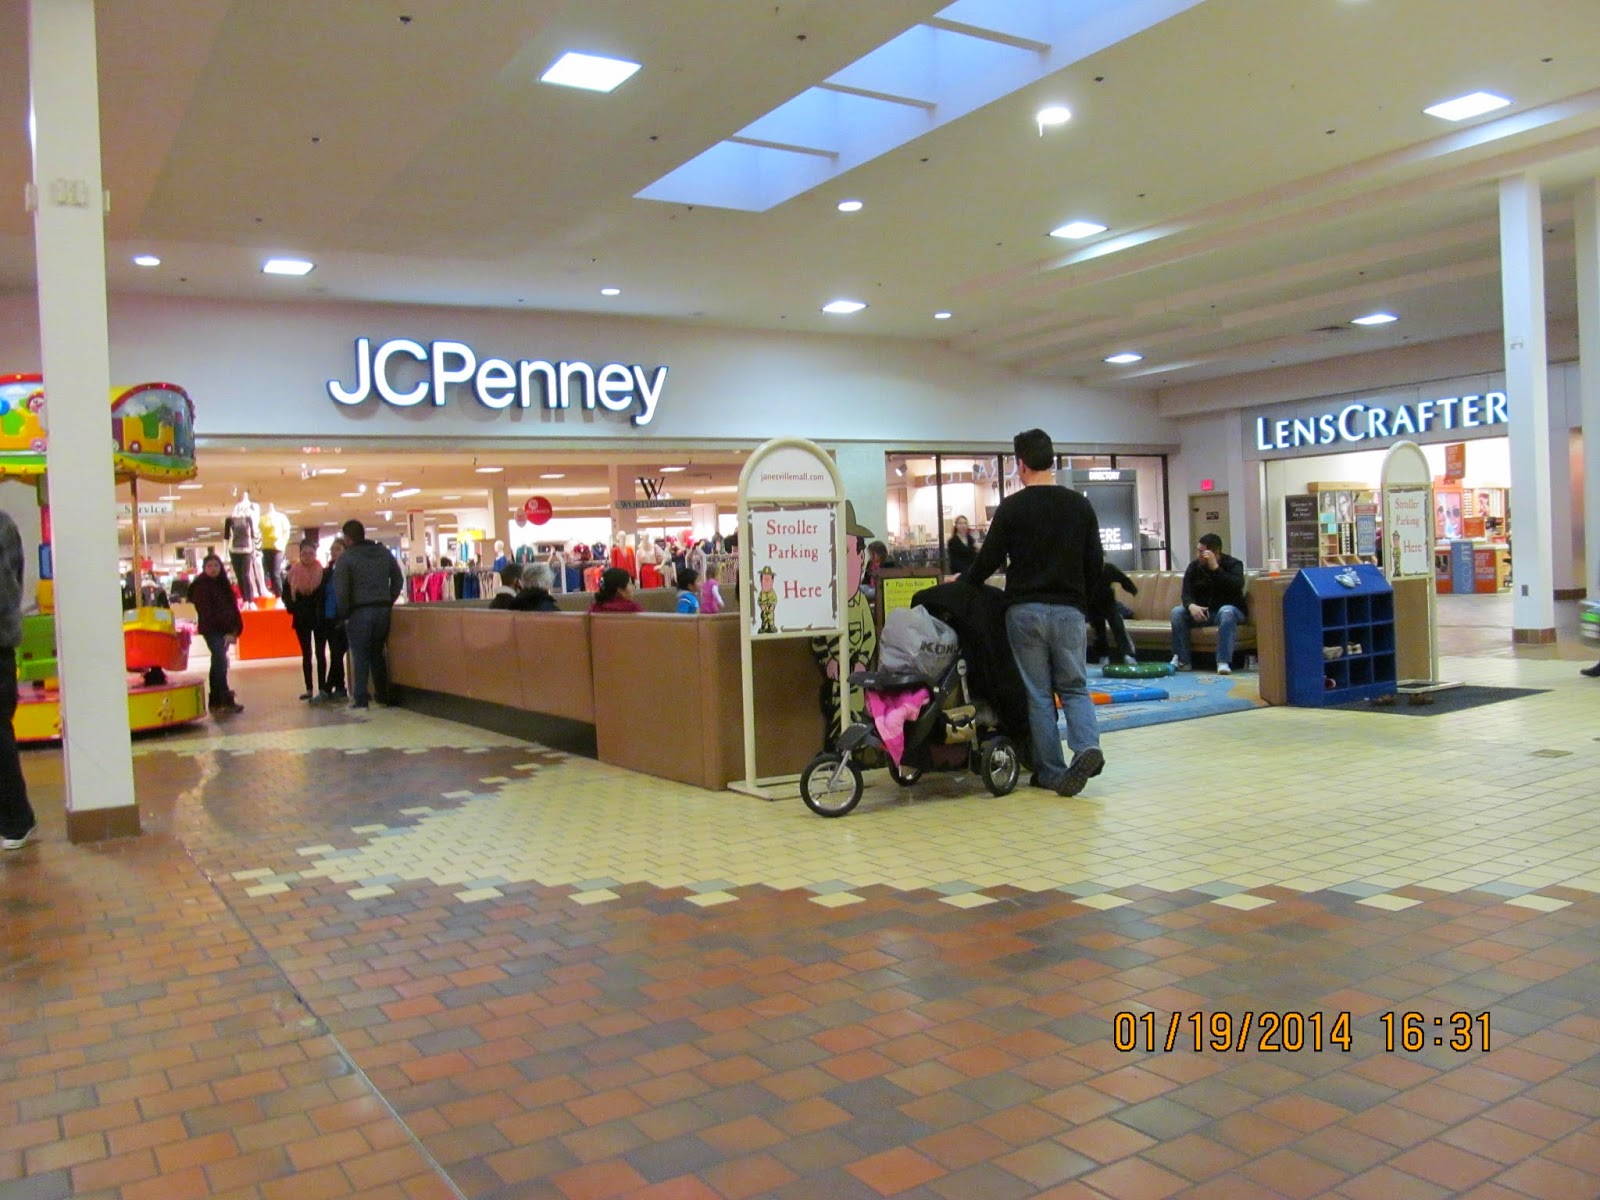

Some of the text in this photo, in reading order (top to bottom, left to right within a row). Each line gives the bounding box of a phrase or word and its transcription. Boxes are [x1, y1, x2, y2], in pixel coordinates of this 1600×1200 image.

[326, 337, 669, 427] JCPenney
[760, 472, 824, 482] janesvillemall.com
[1088, 471, 1120, 481] DIRECTORY
[124, 505, 167, 515] Srvice
[1395, 498, 1419, 509] Stroller
[766, 519, 819, 535] Stroller
[1396, 515, 1420, 528] Parking
[768, 543, 819, 562] Parking
[1403, 540, 1422, 553] Here
[784, 580, 822, 598] Here
